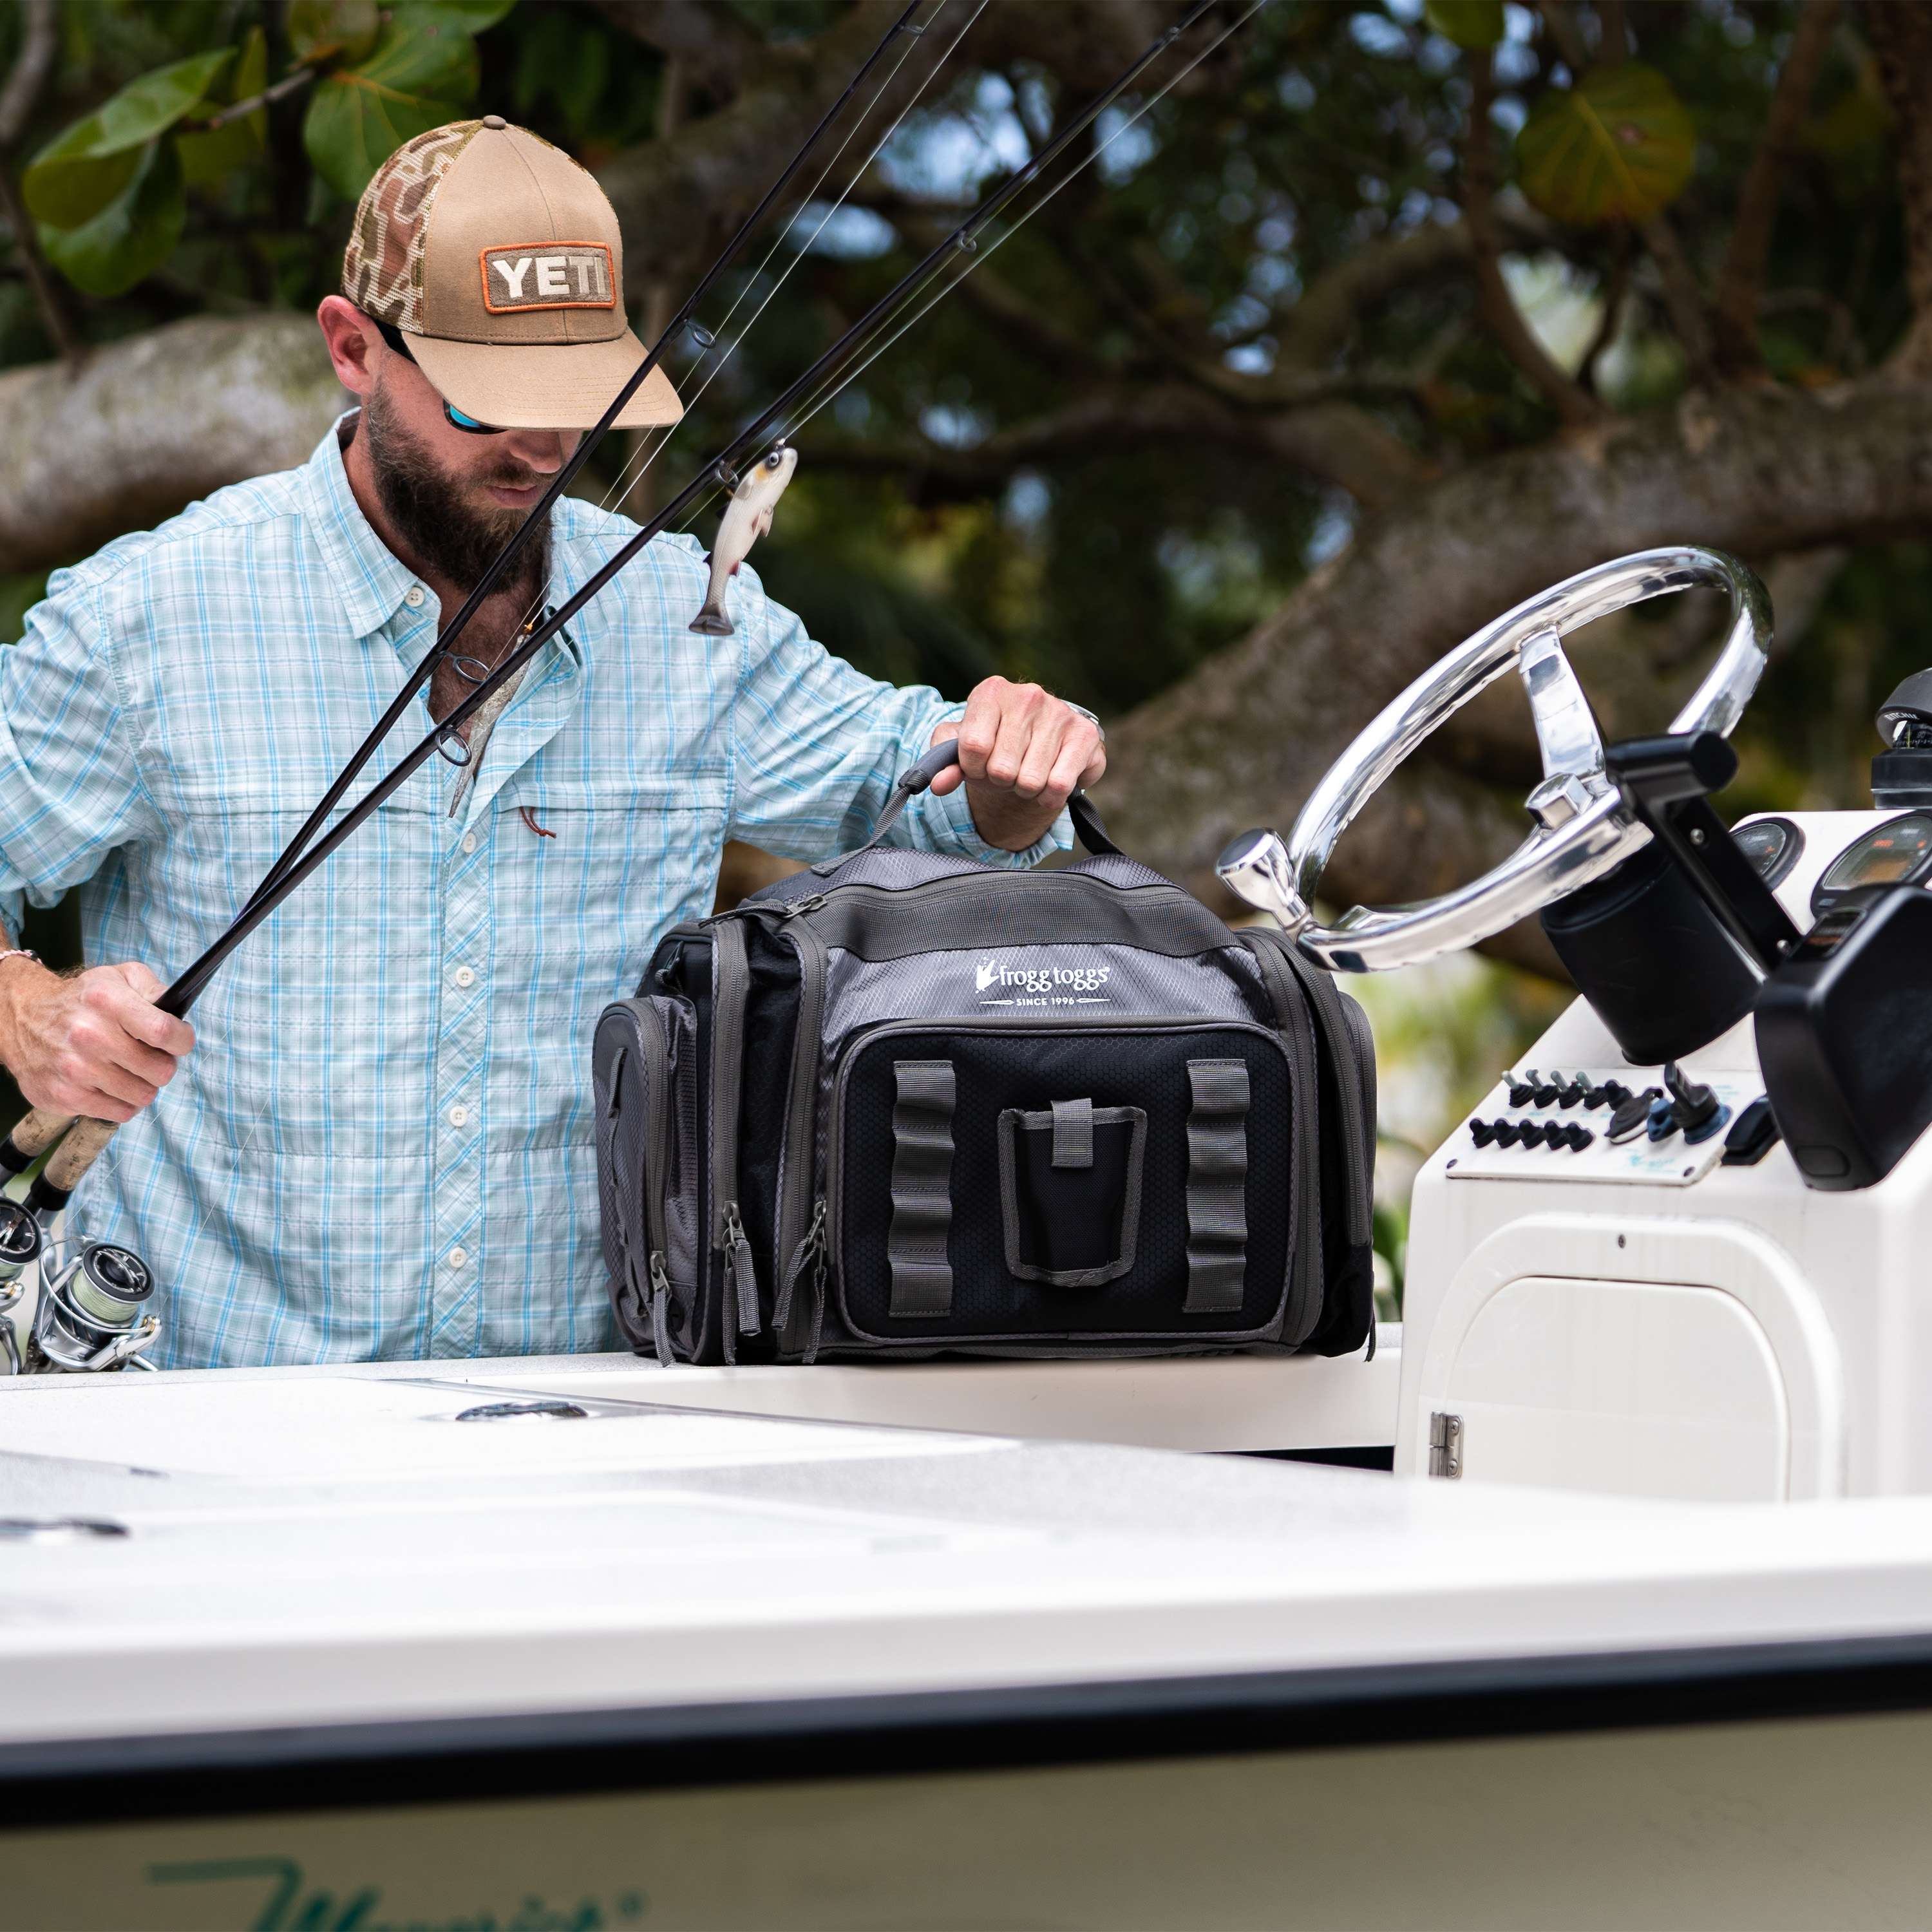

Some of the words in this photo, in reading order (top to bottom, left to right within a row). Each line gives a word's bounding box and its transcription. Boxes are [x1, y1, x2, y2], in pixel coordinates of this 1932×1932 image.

[492, 256, 606, 298] YETI
[999, 965, 1052, 992] frogg
[1053, 967, 1110, 990] toggs
